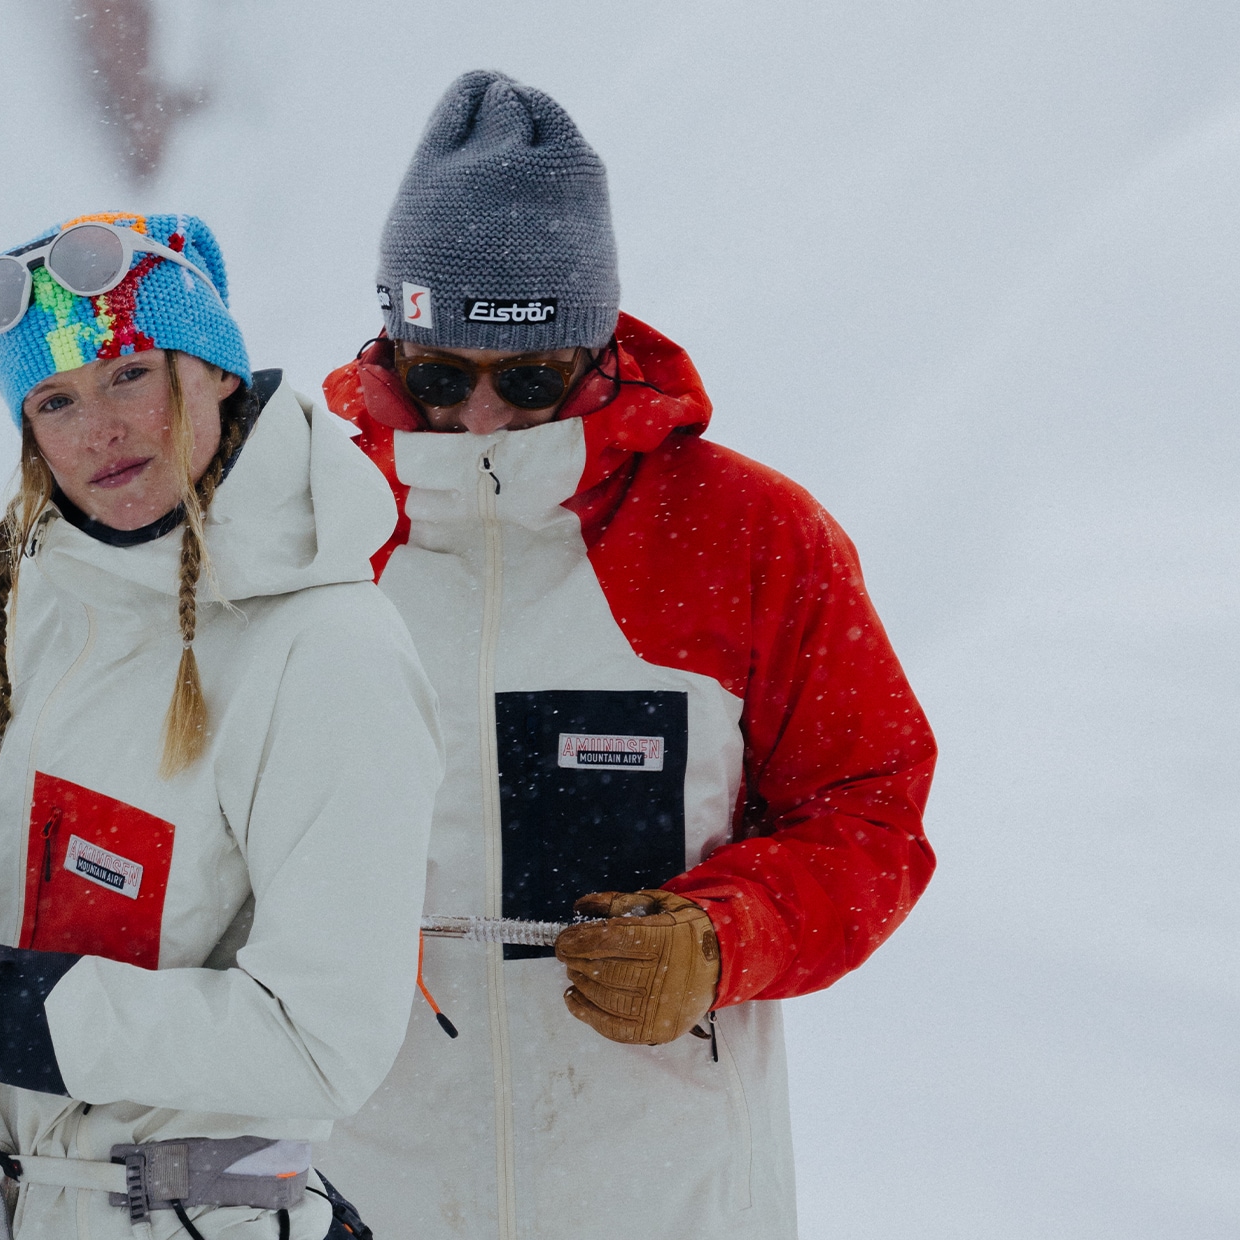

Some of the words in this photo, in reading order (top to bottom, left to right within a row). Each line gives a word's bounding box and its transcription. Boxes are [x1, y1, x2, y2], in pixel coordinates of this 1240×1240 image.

[468, 301, 555, 322] Eisbär
[562, 737, 661, 760] AMUNDSEN
[579, 752, 621, 764] MOUNTAIN
[623, 754, 643, 764] AIRY
[69, 839, 140, 888] AMUNDSEN
[77, 857, 107, 881] MOUNTAIN
[106, 871, 124, 887] AIRY
